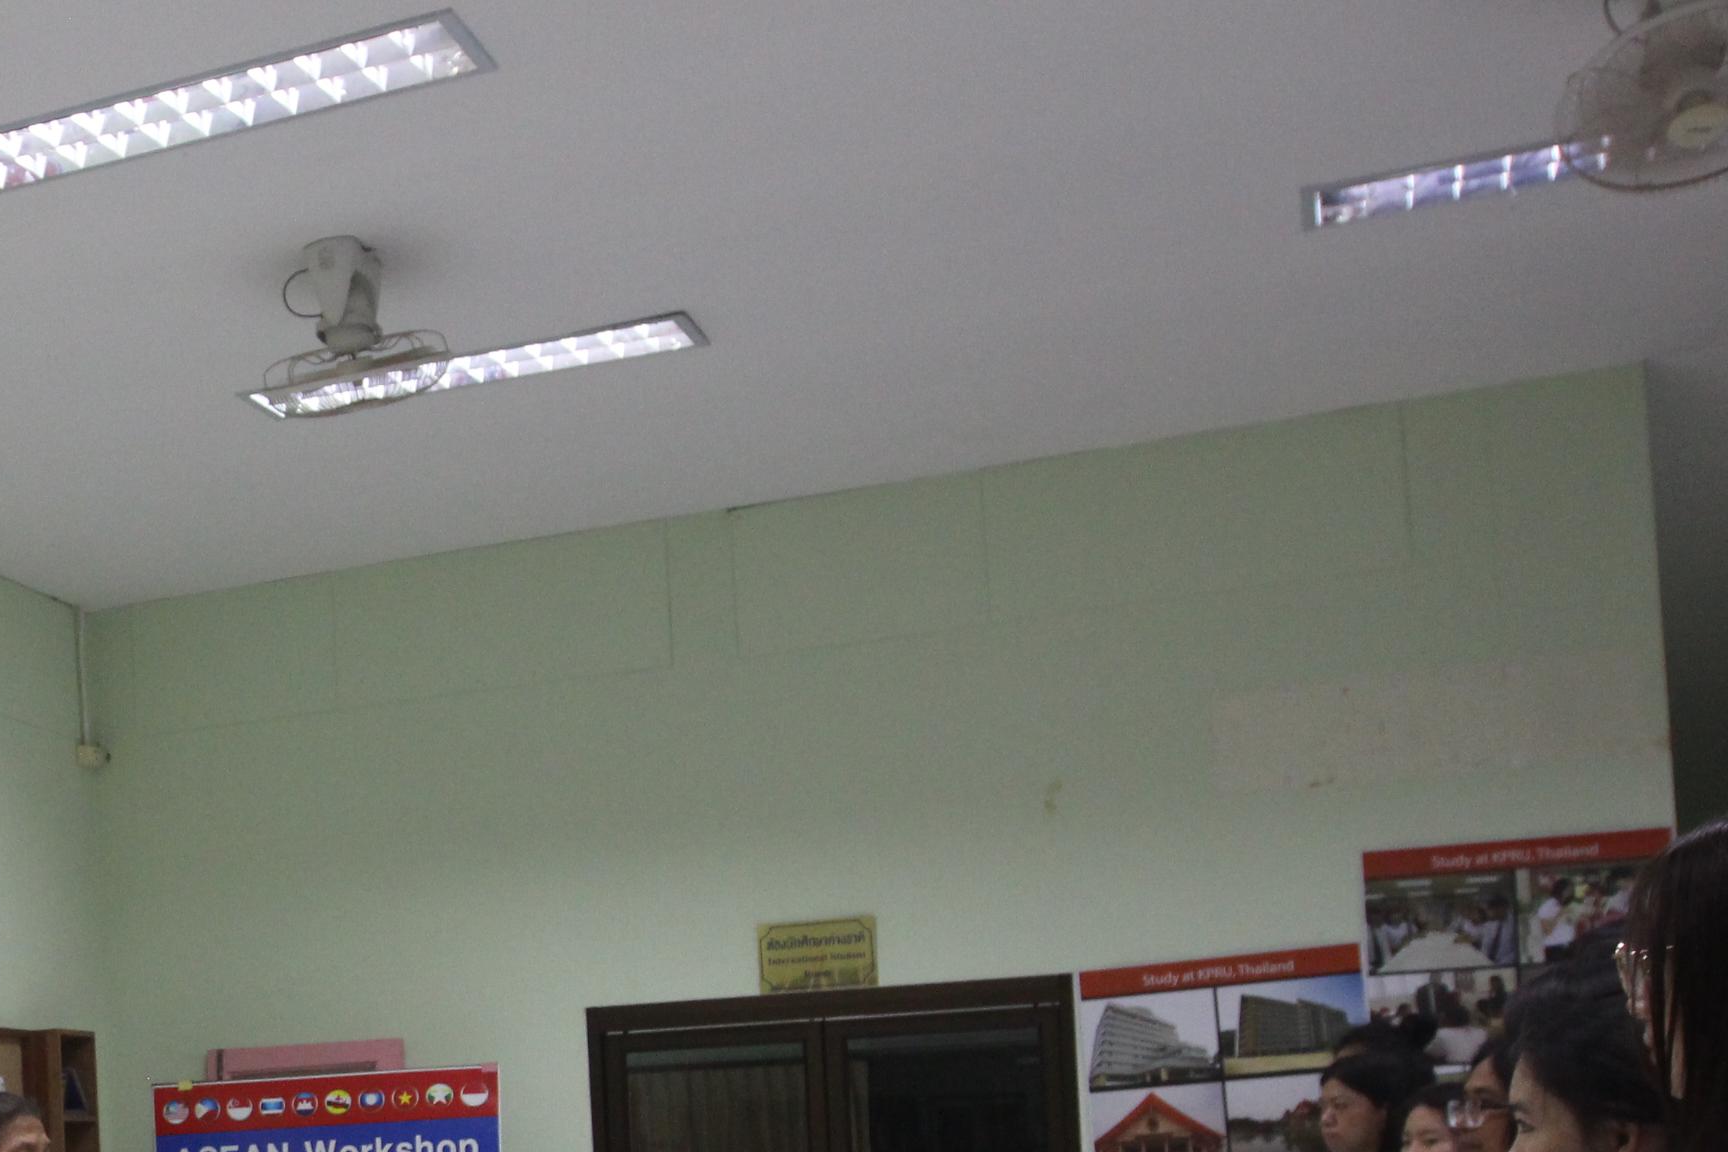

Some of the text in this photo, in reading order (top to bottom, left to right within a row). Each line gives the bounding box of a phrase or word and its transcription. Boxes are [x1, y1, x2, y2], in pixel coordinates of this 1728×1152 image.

[1142, 972, 1180, 987] Study
[1183, 970, 1195, 983] at
[1238, 960, 1295, 976] Thailand
